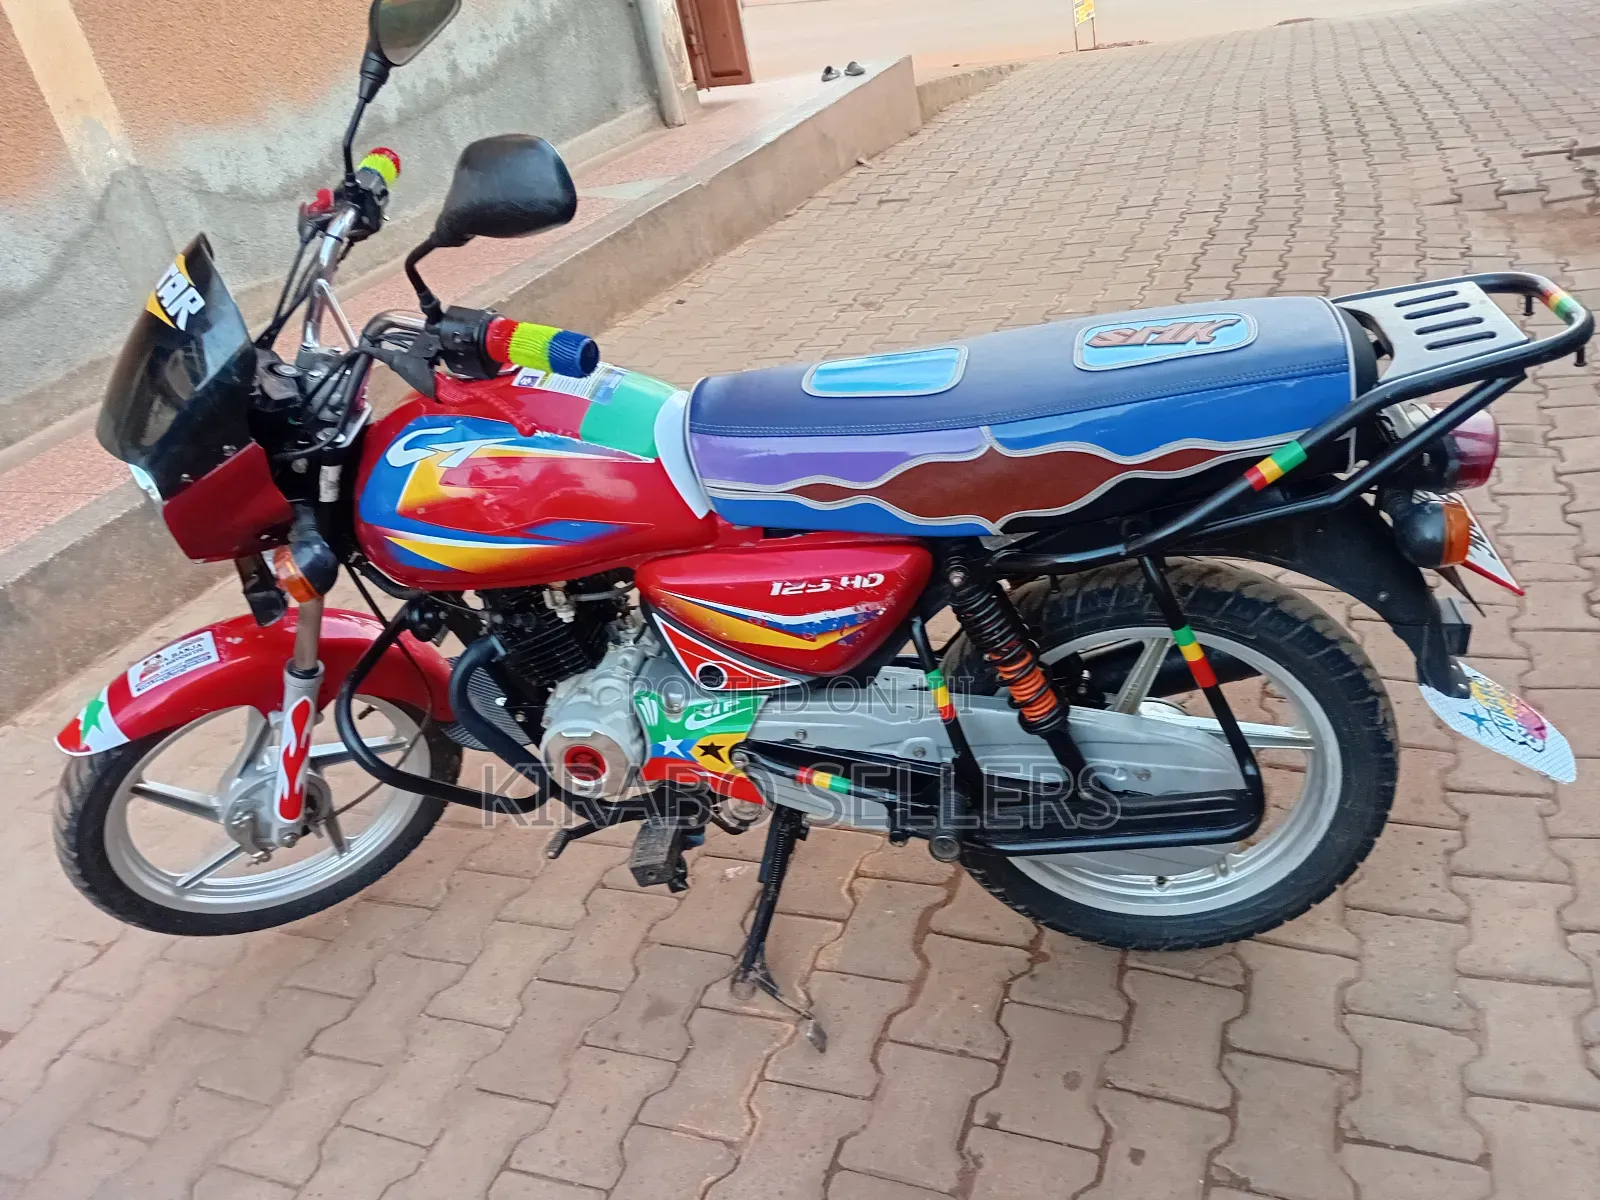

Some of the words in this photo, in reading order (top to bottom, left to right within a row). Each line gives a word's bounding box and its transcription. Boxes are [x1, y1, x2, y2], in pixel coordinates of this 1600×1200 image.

[385, 426, 517, 468] CT
[770, 579, 832, 596] 125
[840, 572, 885, 590] HD
